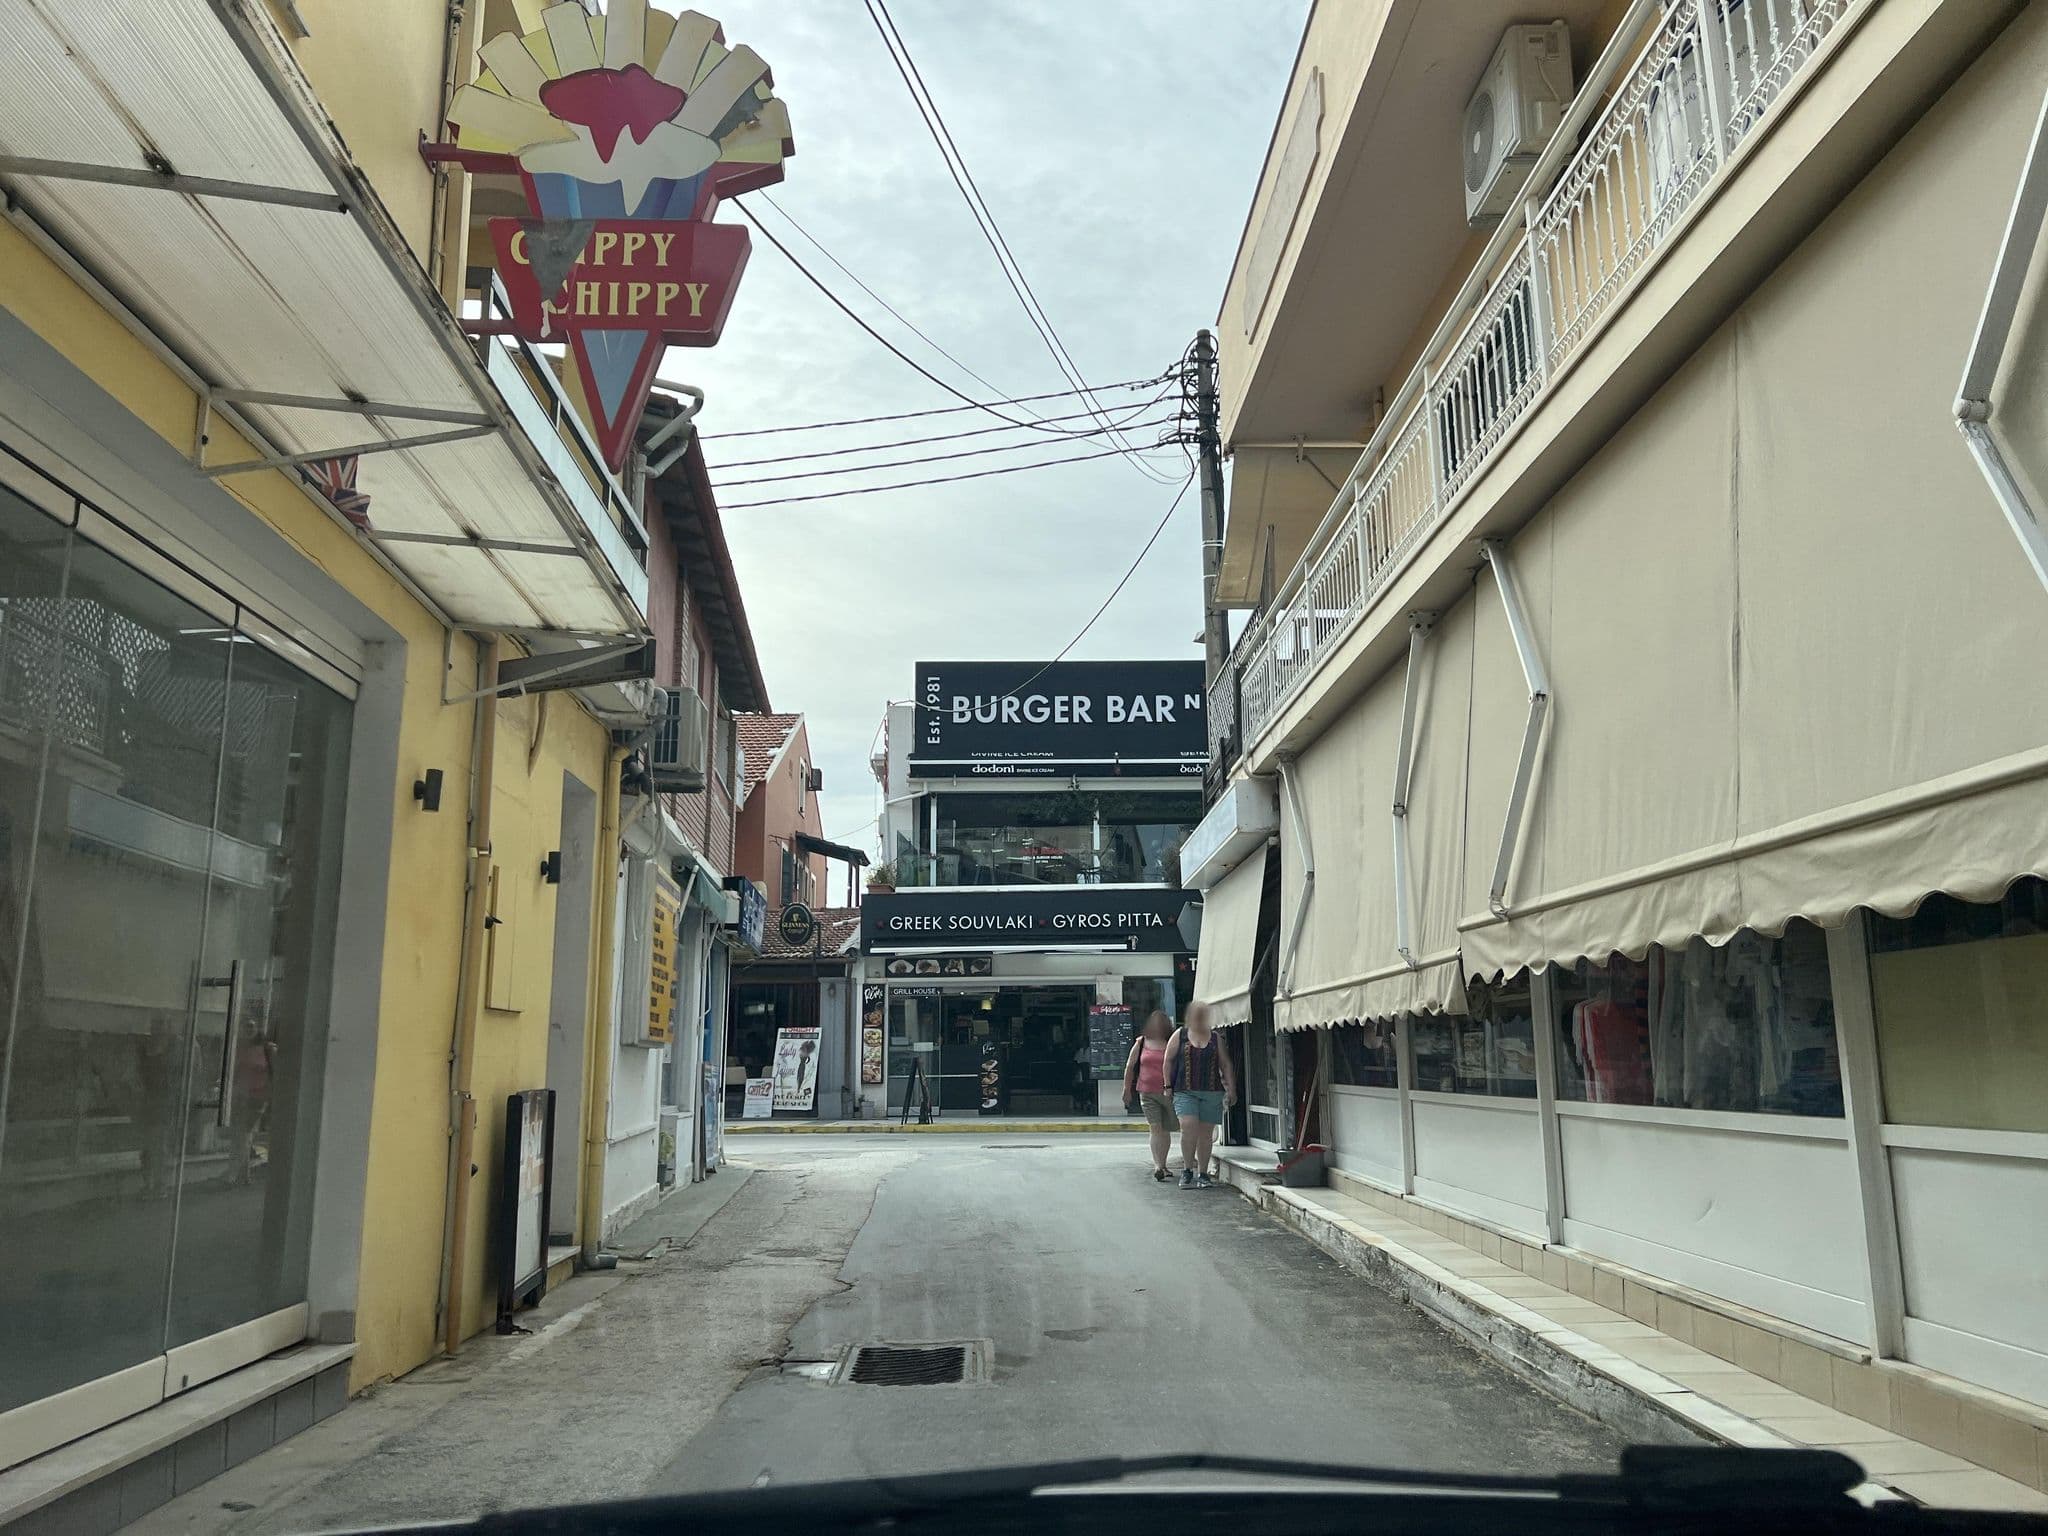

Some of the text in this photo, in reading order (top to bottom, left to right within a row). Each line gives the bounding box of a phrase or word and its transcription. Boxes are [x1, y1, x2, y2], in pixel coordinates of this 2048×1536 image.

[510, 230, 676, 266] CPPY
[952, 694, 1176, 724] BURGER BAR
[927, 716, 940, 744] Est.
[972, 764, 1015, 773] dodoni
[889, 912, 1164, 930] GREEK SOUVLAKI GYROS PITTA
[913, 987, 937, 995] HOUSE
